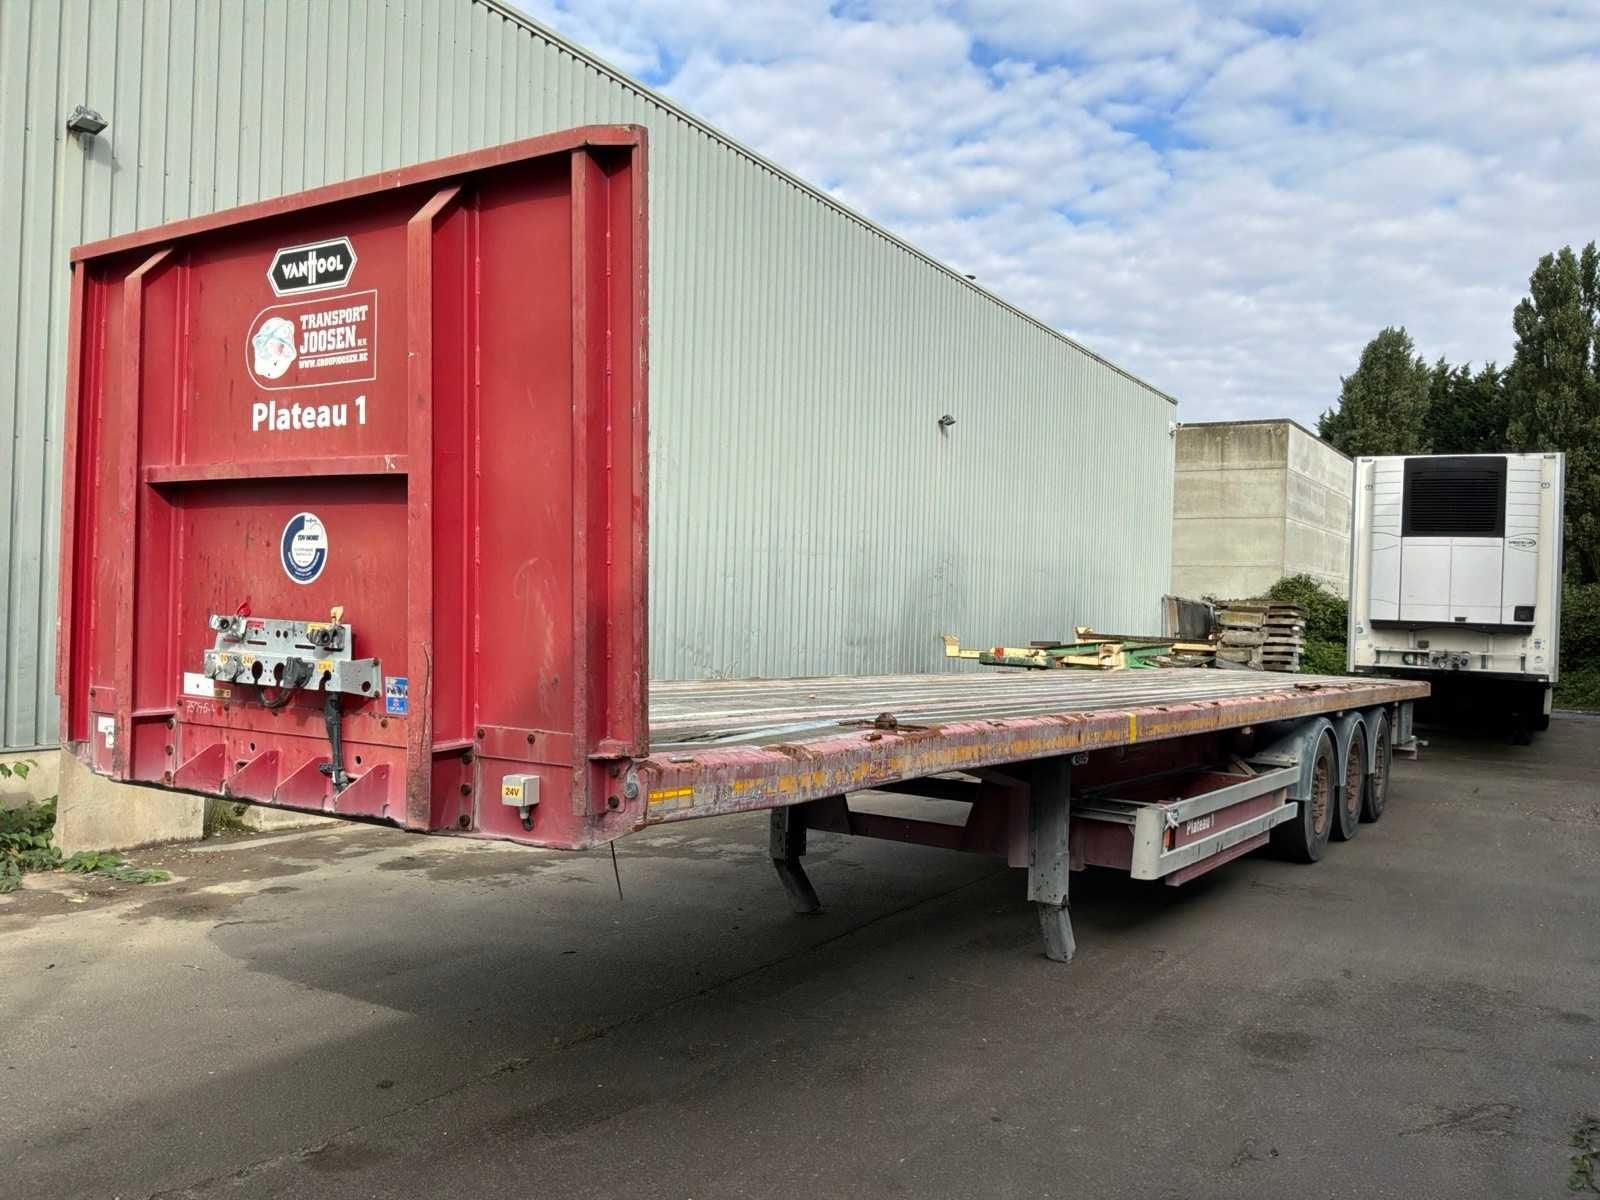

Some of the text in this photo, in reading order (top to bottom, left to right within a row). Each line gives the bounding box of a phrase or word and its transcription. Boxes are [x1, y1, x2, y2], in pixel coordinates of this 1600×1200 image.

[300, 304, 368, 330] TRANSPORT
[300, 325, 356, 353] JOOSEN
[252, 395, 366, 431] Plateau 1
[505, 787, 520, 796] 24V
[1186, 816, 1210, 835] Plateau
